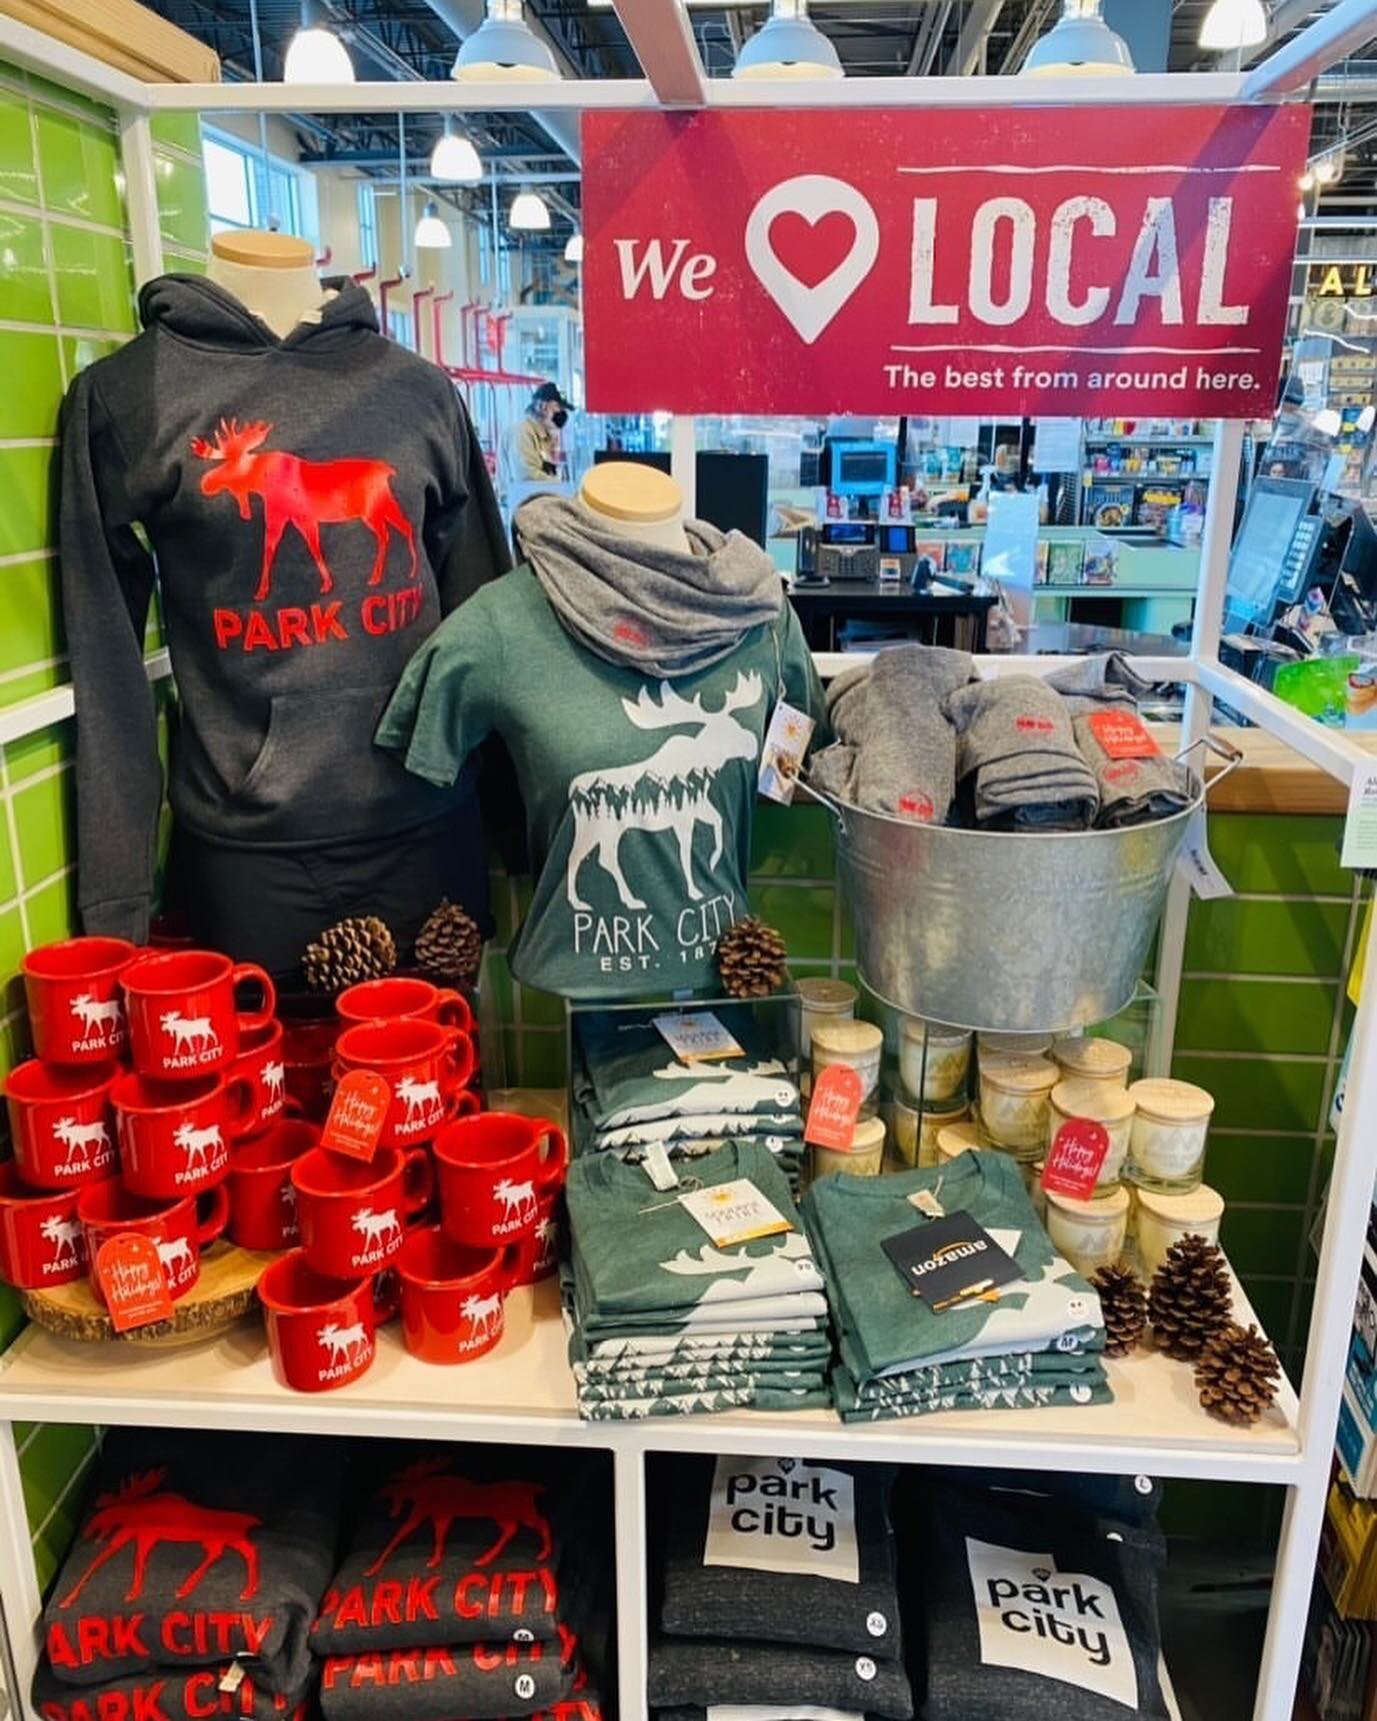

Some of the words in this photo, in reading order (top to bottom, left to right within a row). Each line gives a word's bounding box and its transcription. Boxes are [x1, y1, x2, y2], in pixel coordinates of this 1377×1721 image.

[613, 239, 717, 300] We
[908, 194, 1250, 327] LOCAL
[883, 365, 936, 389] The
[945, 365, 1004, 389] best
[1012, 365, 1079, 389] from
[1087, 366, 1187, 390] around
[1195, 367, 1261, 391] here.
[213, 601, 348, 652] PARK
[573, 913, 660, 952] PARK
[677, 891, 736, 947] CITY
[600, 955, 661, 972] EST.
[72, 1036, 107, 1053] PARK
[162, 1055, 197, 1070] PARK
[395, 1118, 426, 1136] PARK
[53, 1159, 91, 1176] PARK
[174, 1164, 209, 1184] PARK
[492, 1219, 523, 1236] PARK
[42, 1257, 79, 1274] PARK
[351, 1247, 385, 1267] PARK
[911, 1240, 989, 1276] amazon
[458, 1334, 490, 1352] PARK
[318, 1361, 353, 1381] PARK
[726, 1472, 839, 1511] park
[730, 1503, 836, 1552] city
[986, 1576, 1106, 1620] park
[47, 1612, 150, 1668] ARK
[160, 1611, 274, 1655] CITY
[1001, 1606, 1113, 1667] city
